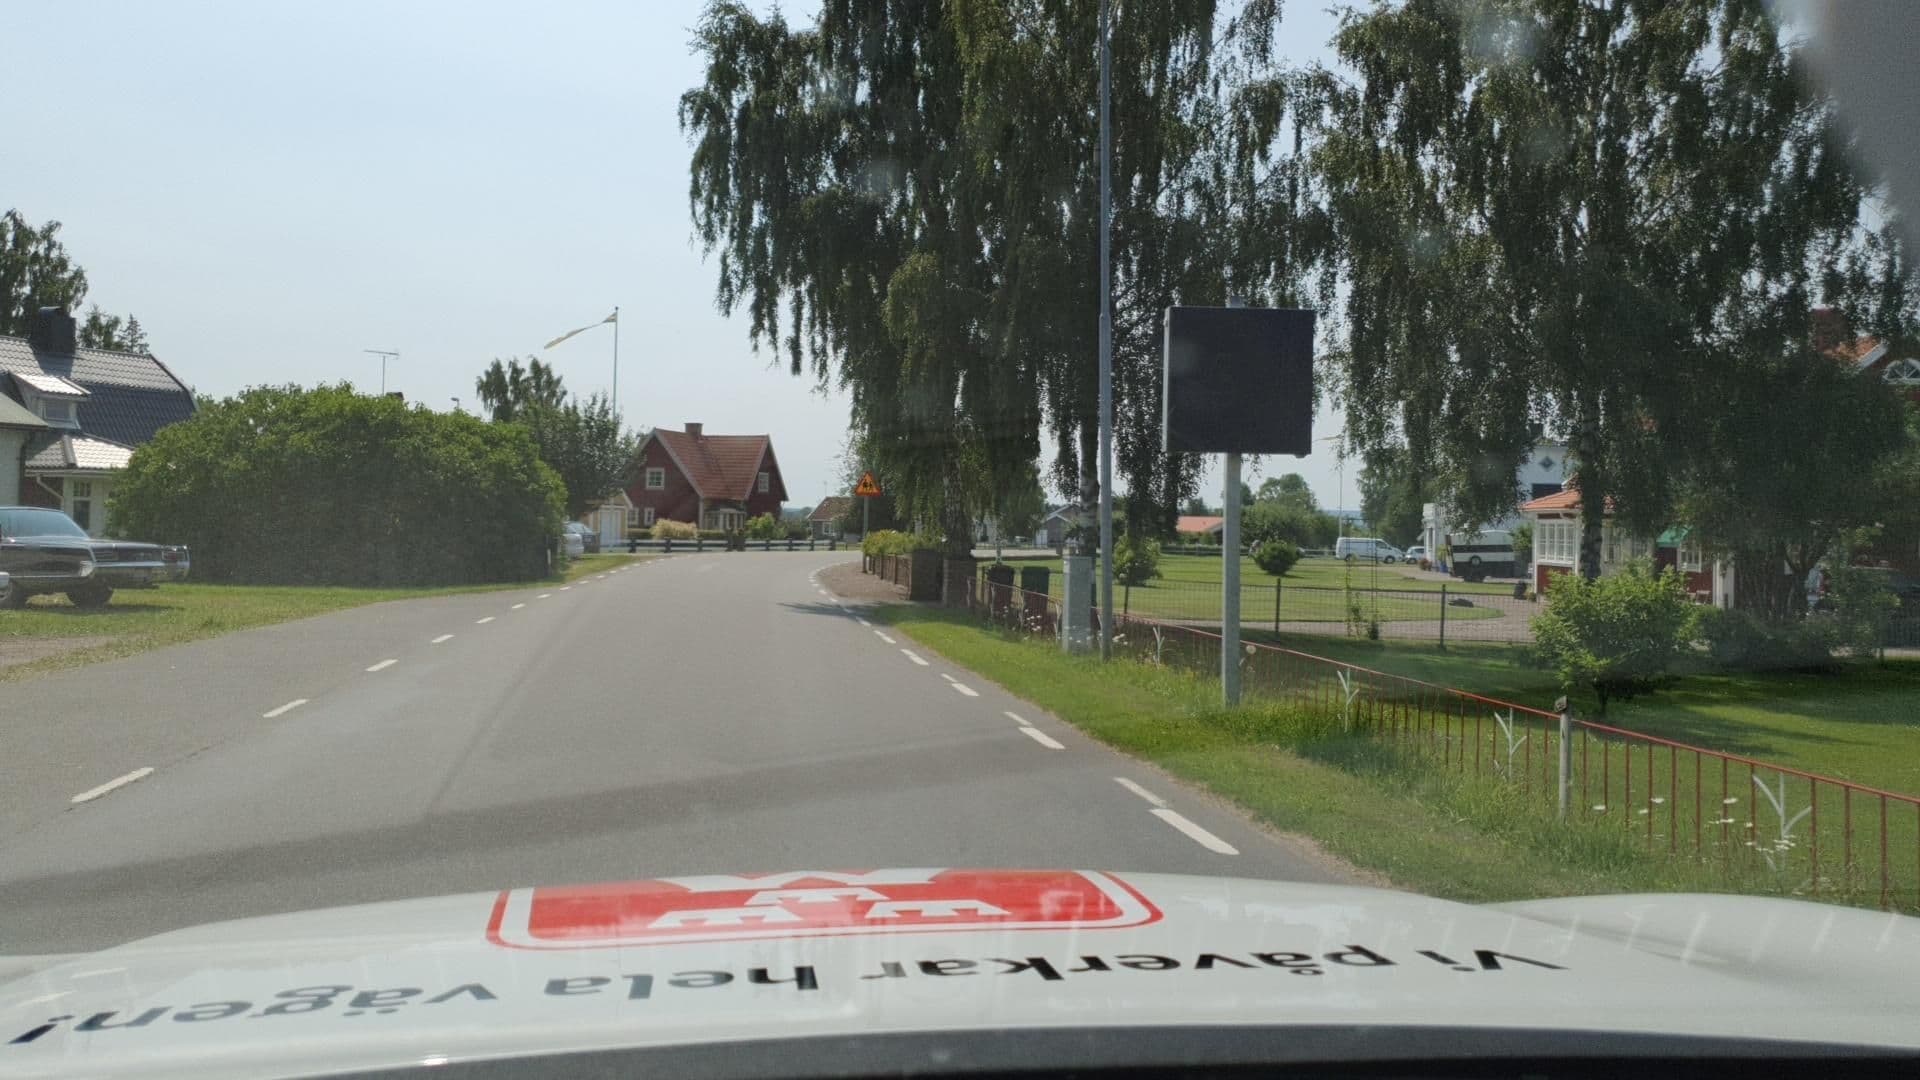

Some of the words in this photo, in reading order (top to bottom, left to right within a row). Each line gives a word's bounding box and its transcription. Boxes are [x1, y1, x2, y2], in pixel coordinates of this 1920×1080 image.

[861, 945, 1397, 982] påverkar
[1416, 948, 1570, 972] Vi
[544, 965, 819, 1000] hela
[7, 983, 498, 1045] vägen!
